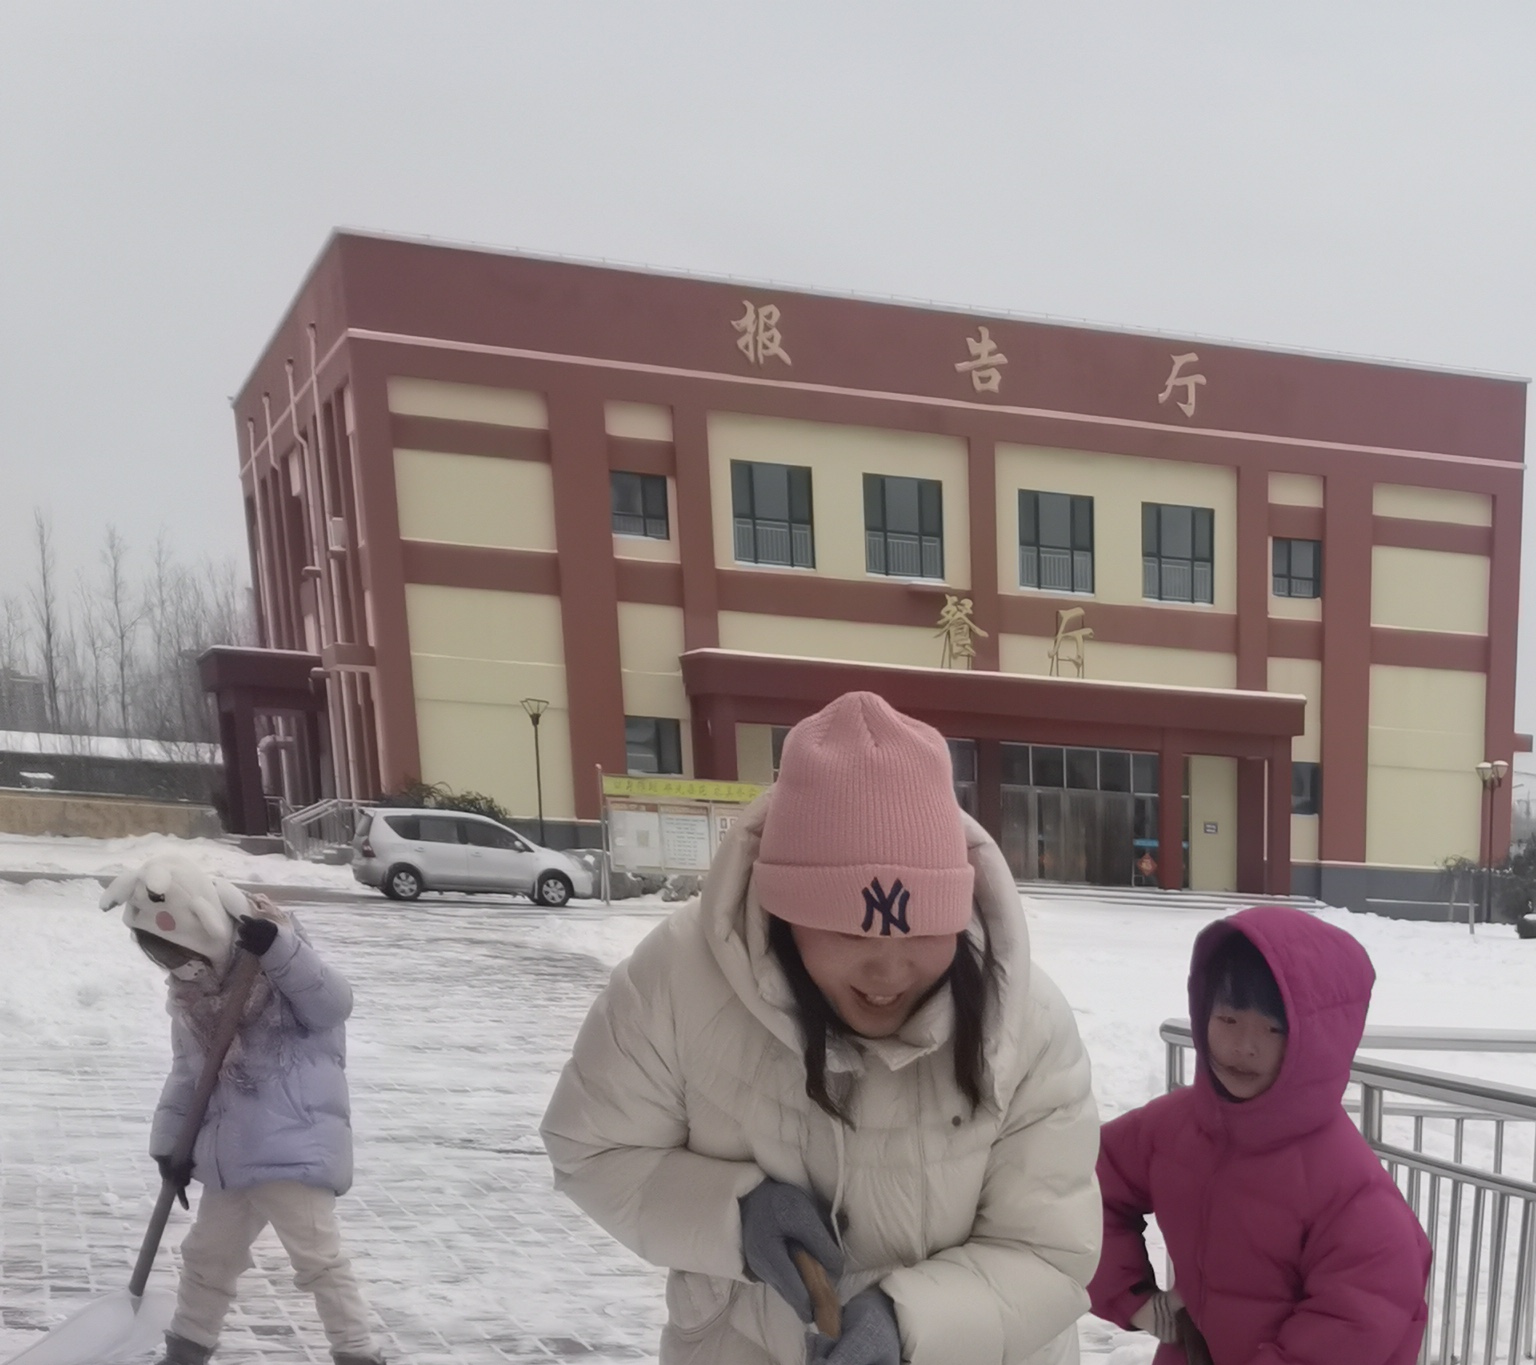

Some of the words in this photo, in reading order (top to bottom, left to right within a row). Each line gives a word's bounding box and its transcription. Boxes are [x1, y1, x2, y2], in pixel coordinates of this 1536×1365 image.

[731, 300, 1207, 417] 报告厅
[933, 594, 1094, 664] 餐厅
[862, 877, 910, 935] NY
